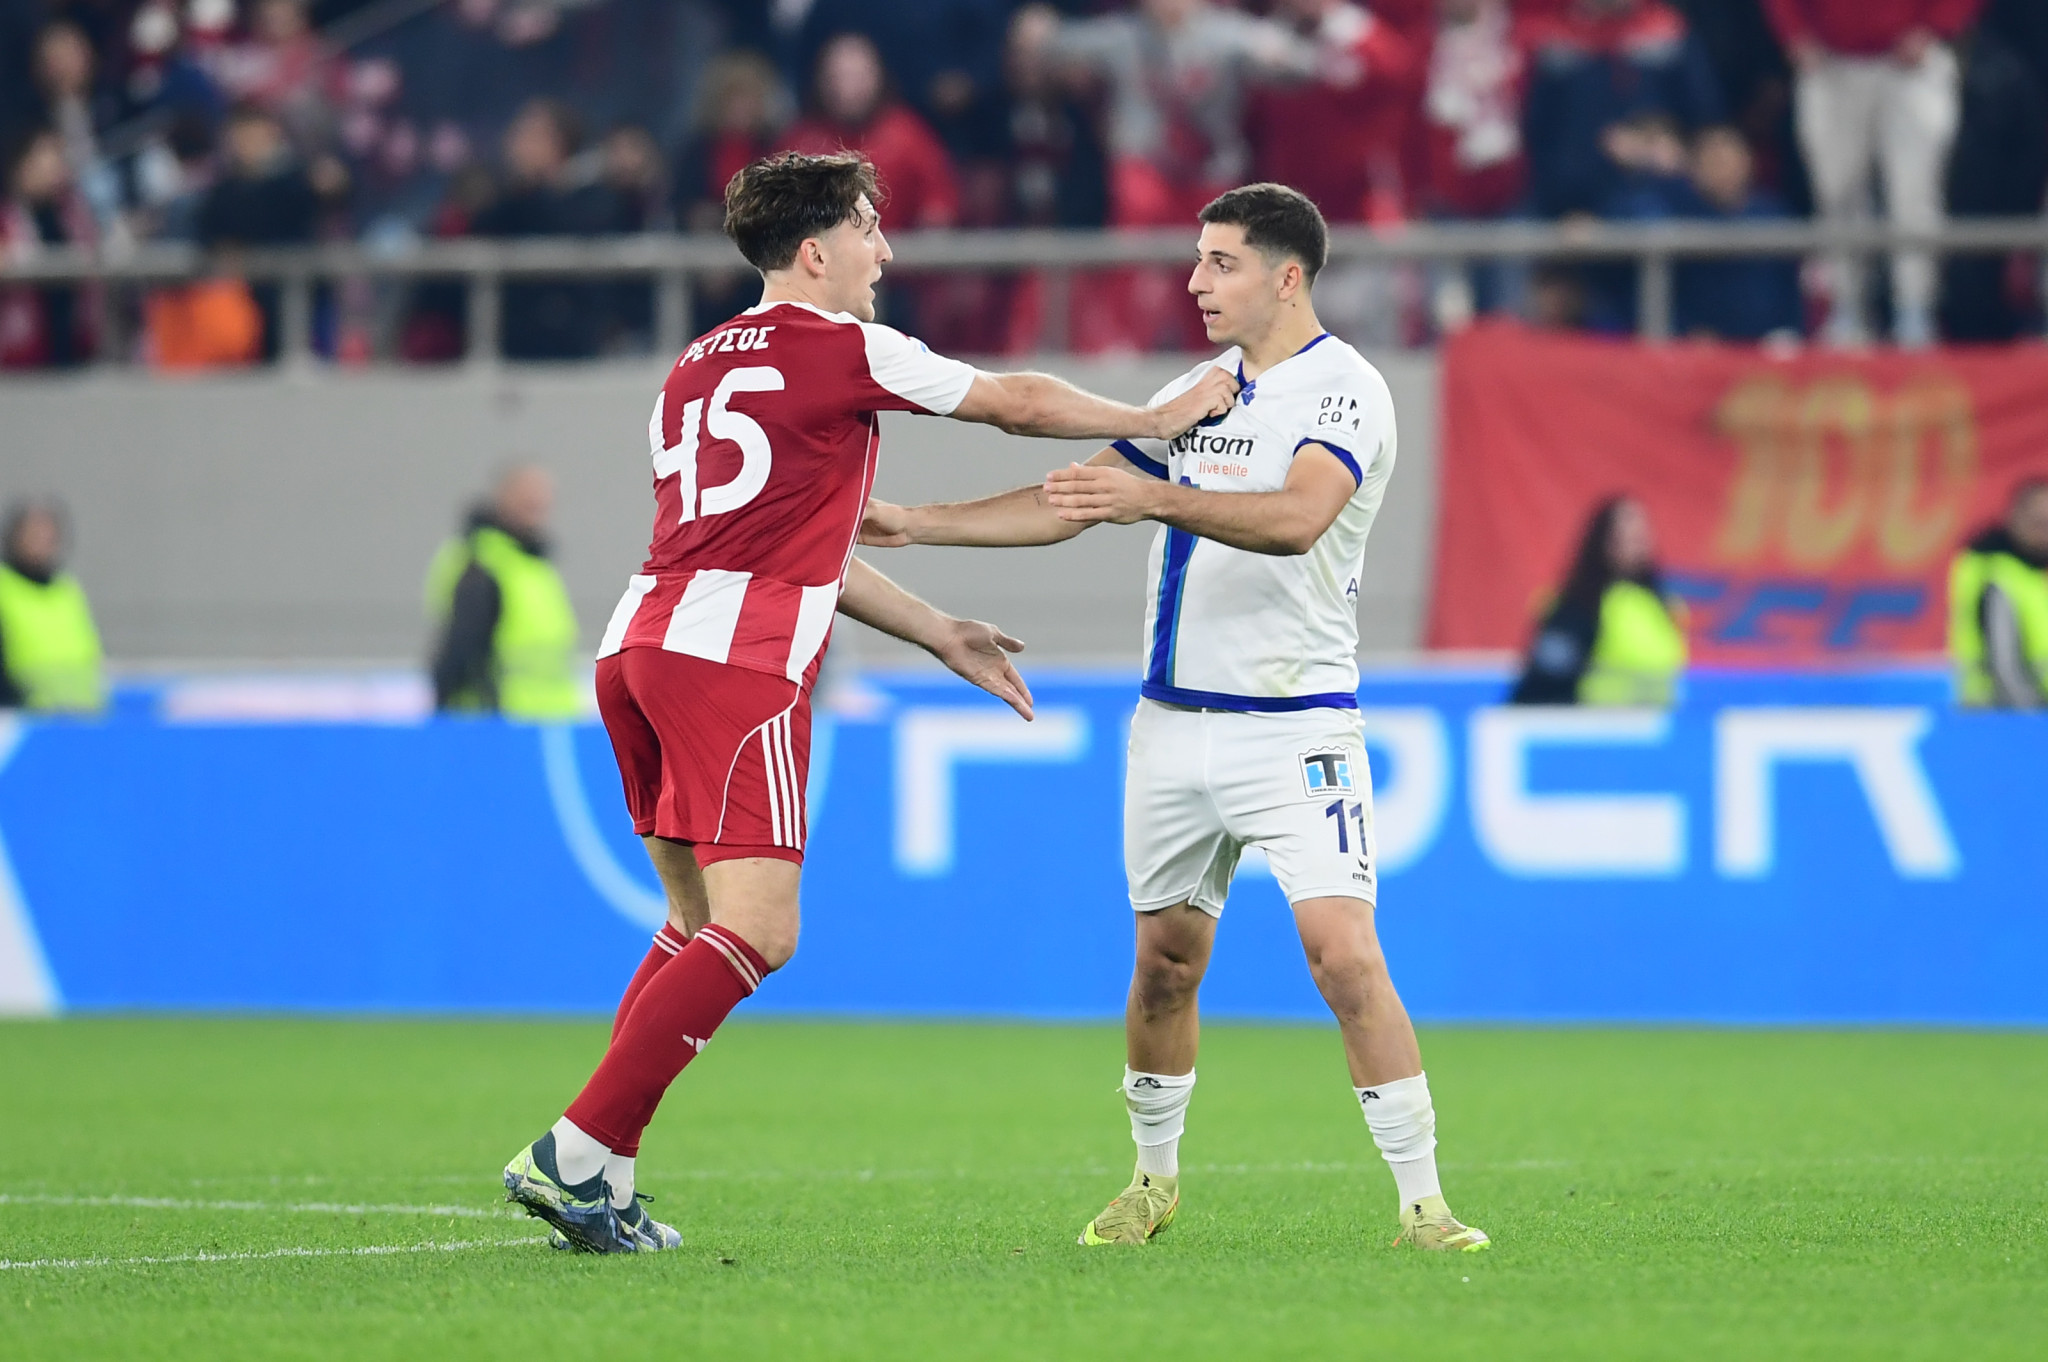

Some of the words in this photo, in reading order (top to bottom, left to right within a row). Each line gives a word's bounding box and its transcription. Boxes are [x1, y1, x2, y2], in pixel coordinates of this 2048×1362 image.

[649, 365, 785, 525] 45
[1198, 461, 1220, 475] live
[1222, 463, 1249, 477] elite
[1325, 799, 1368, 857] 11
